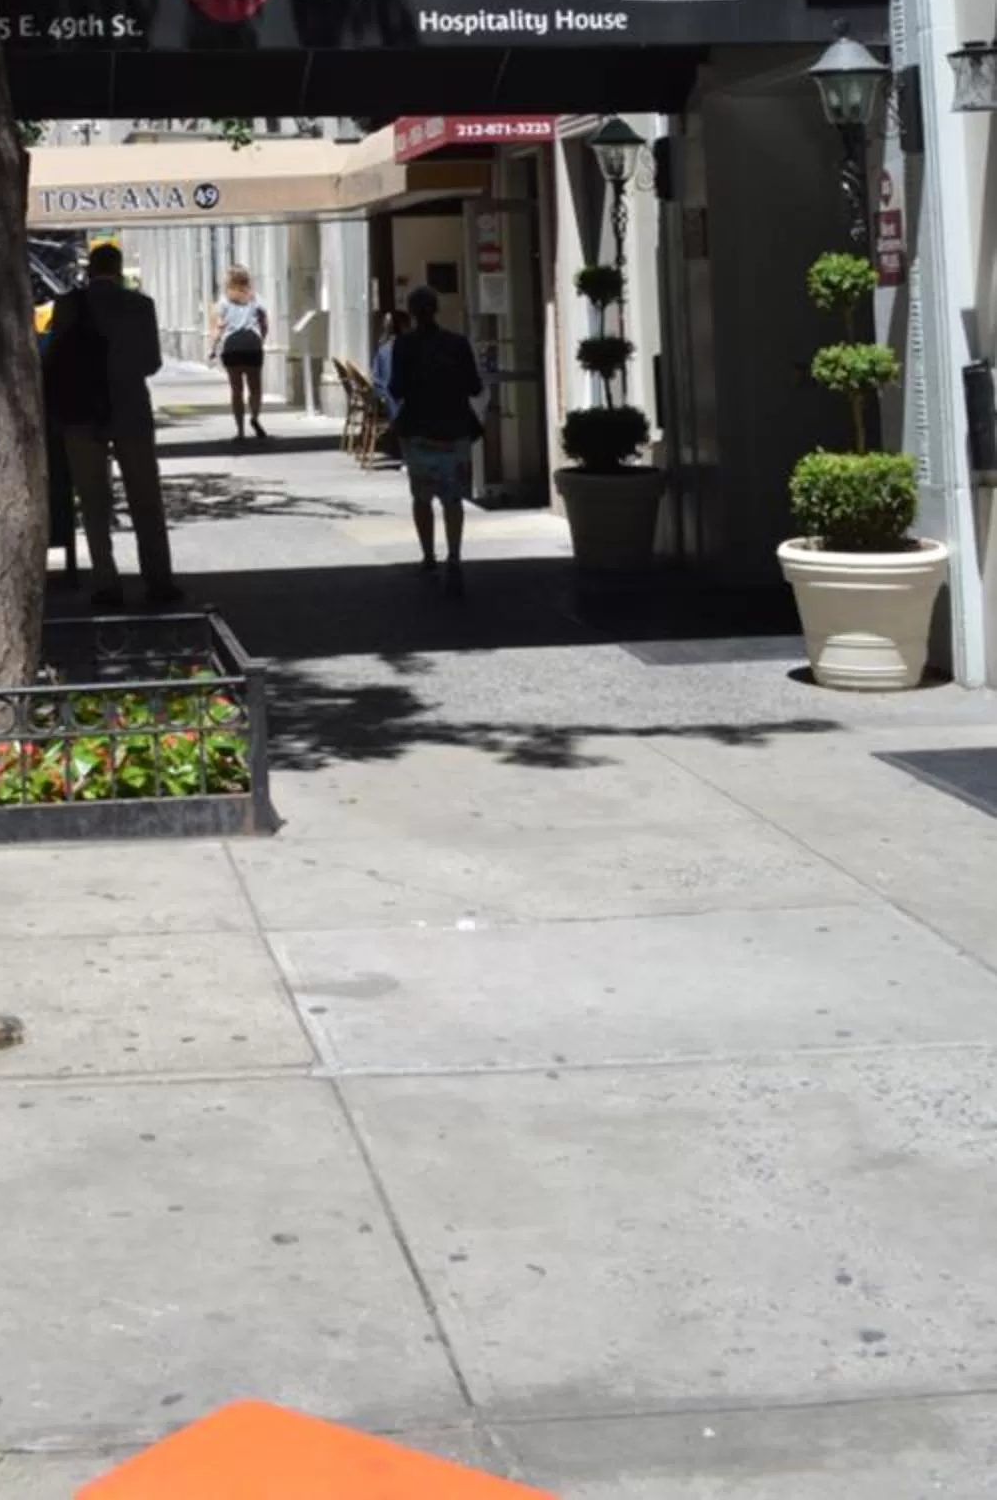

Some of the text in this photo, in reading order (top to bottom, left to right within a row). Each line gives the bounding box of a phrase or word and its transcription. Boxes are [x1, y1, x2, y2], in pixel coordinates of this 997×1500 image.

[19, 14, 42, 37] E.
[47, 13, 104, 40] 49th
[111, 14, 144, 38] St.
[419, 8, 629, 35] Hospitality House
[38, 186, 186, 213] TOSCANA
